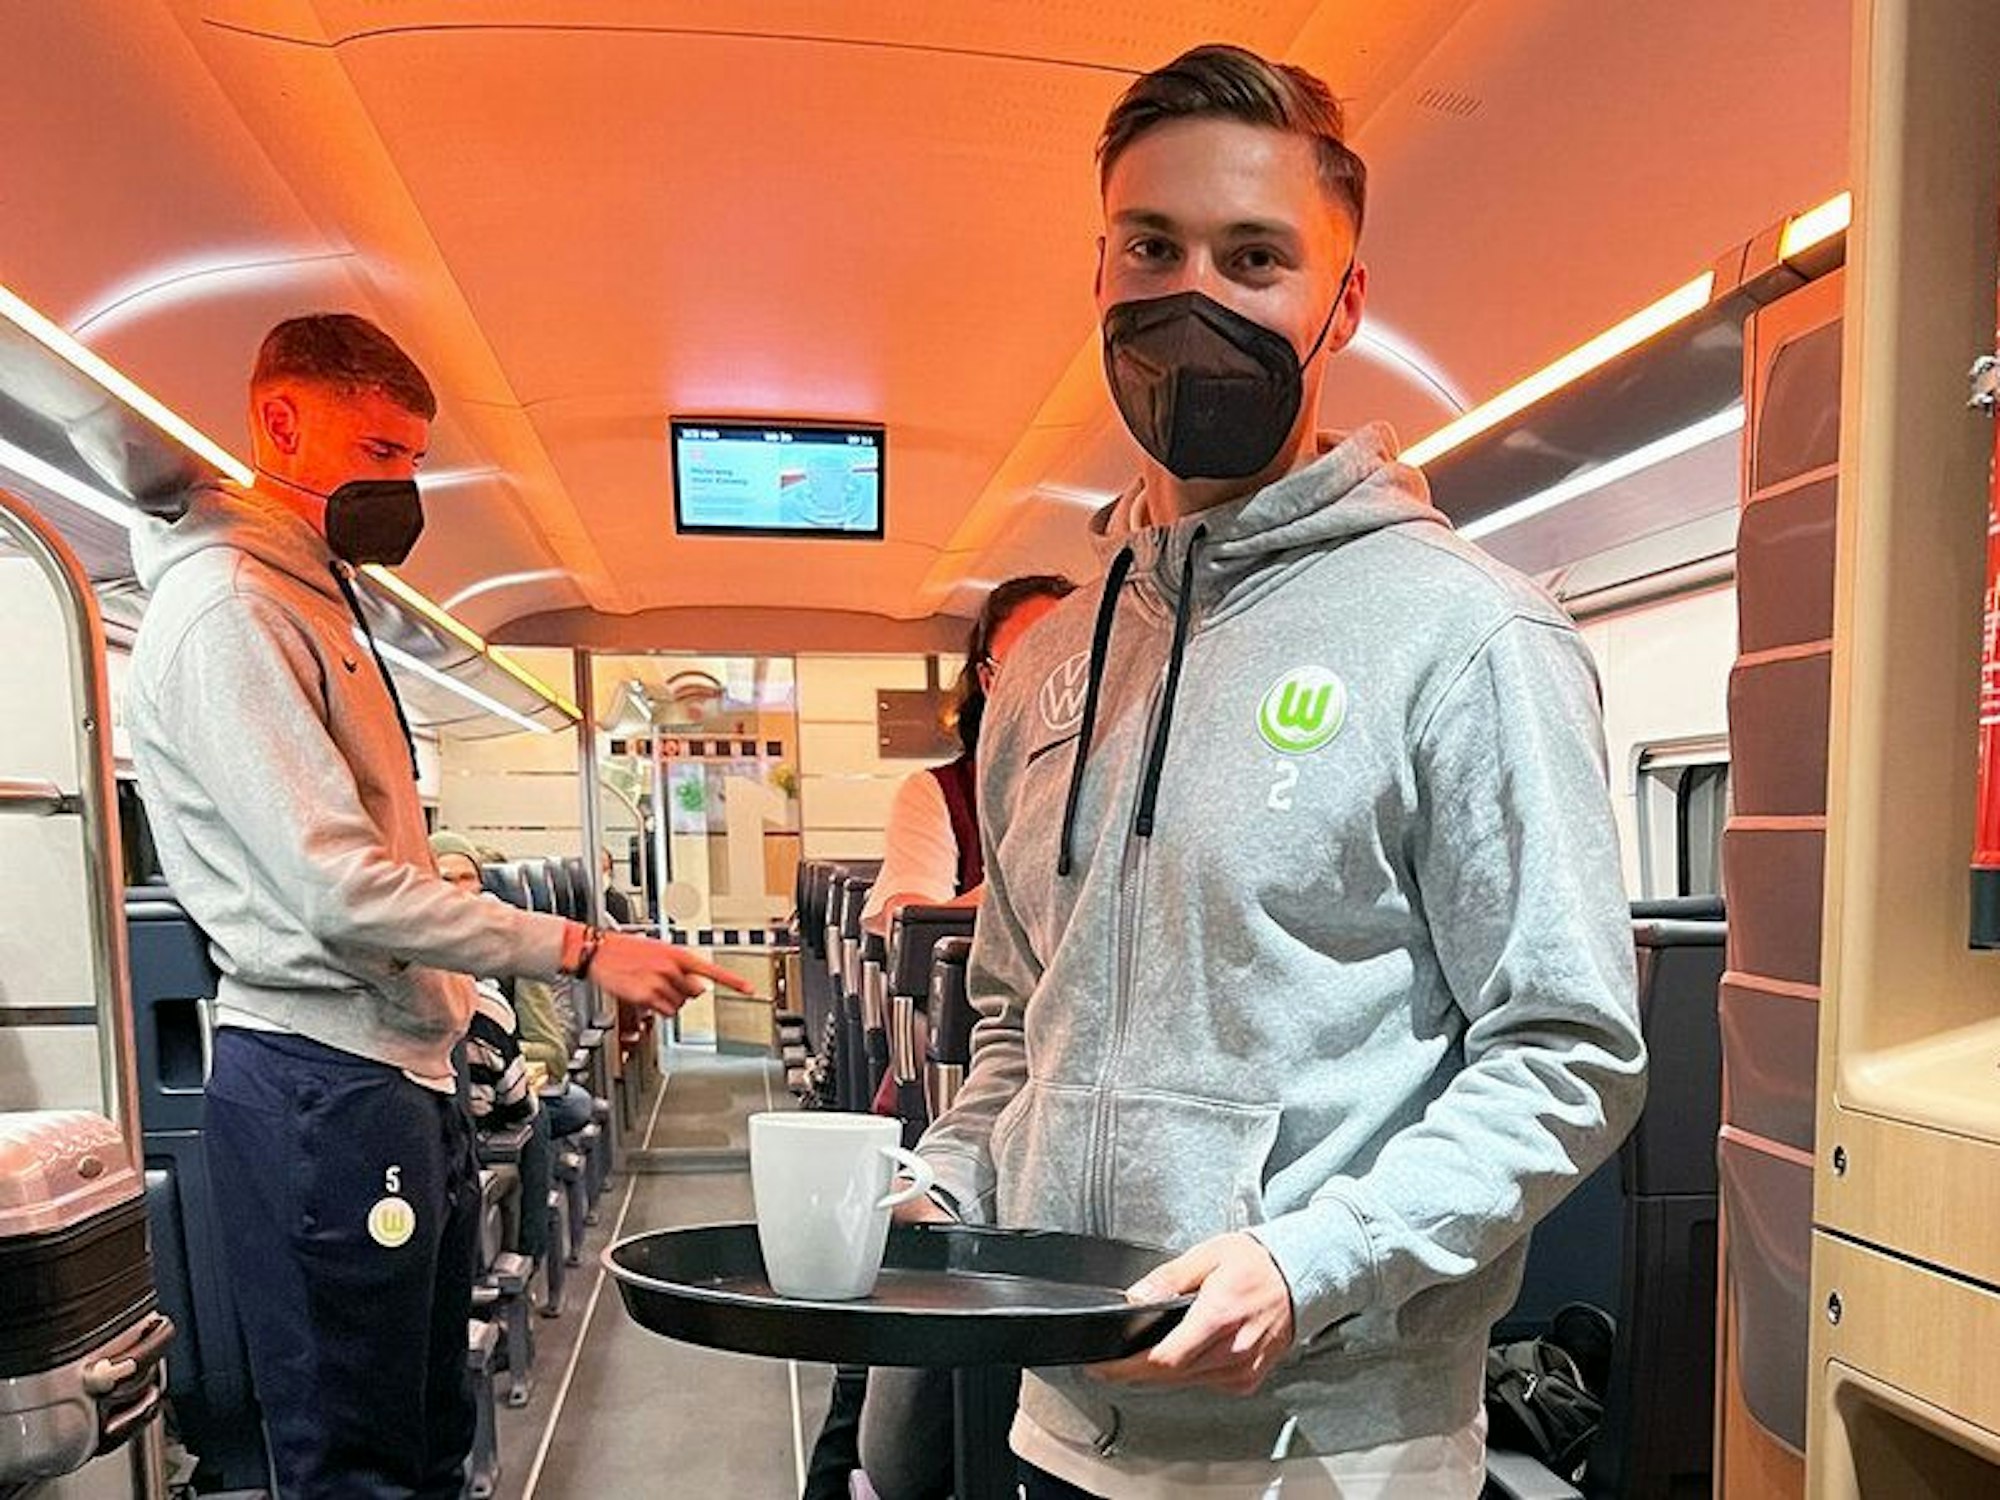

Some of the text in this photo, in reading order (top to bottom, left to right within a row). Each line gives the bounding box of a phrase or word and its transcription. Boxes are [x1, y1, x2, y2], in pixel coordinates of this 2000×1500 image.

[1277, 681, 1333, 731] W
[1267, 760, 1300, 811] 2
[385, 1165, 402, 1193] 5
